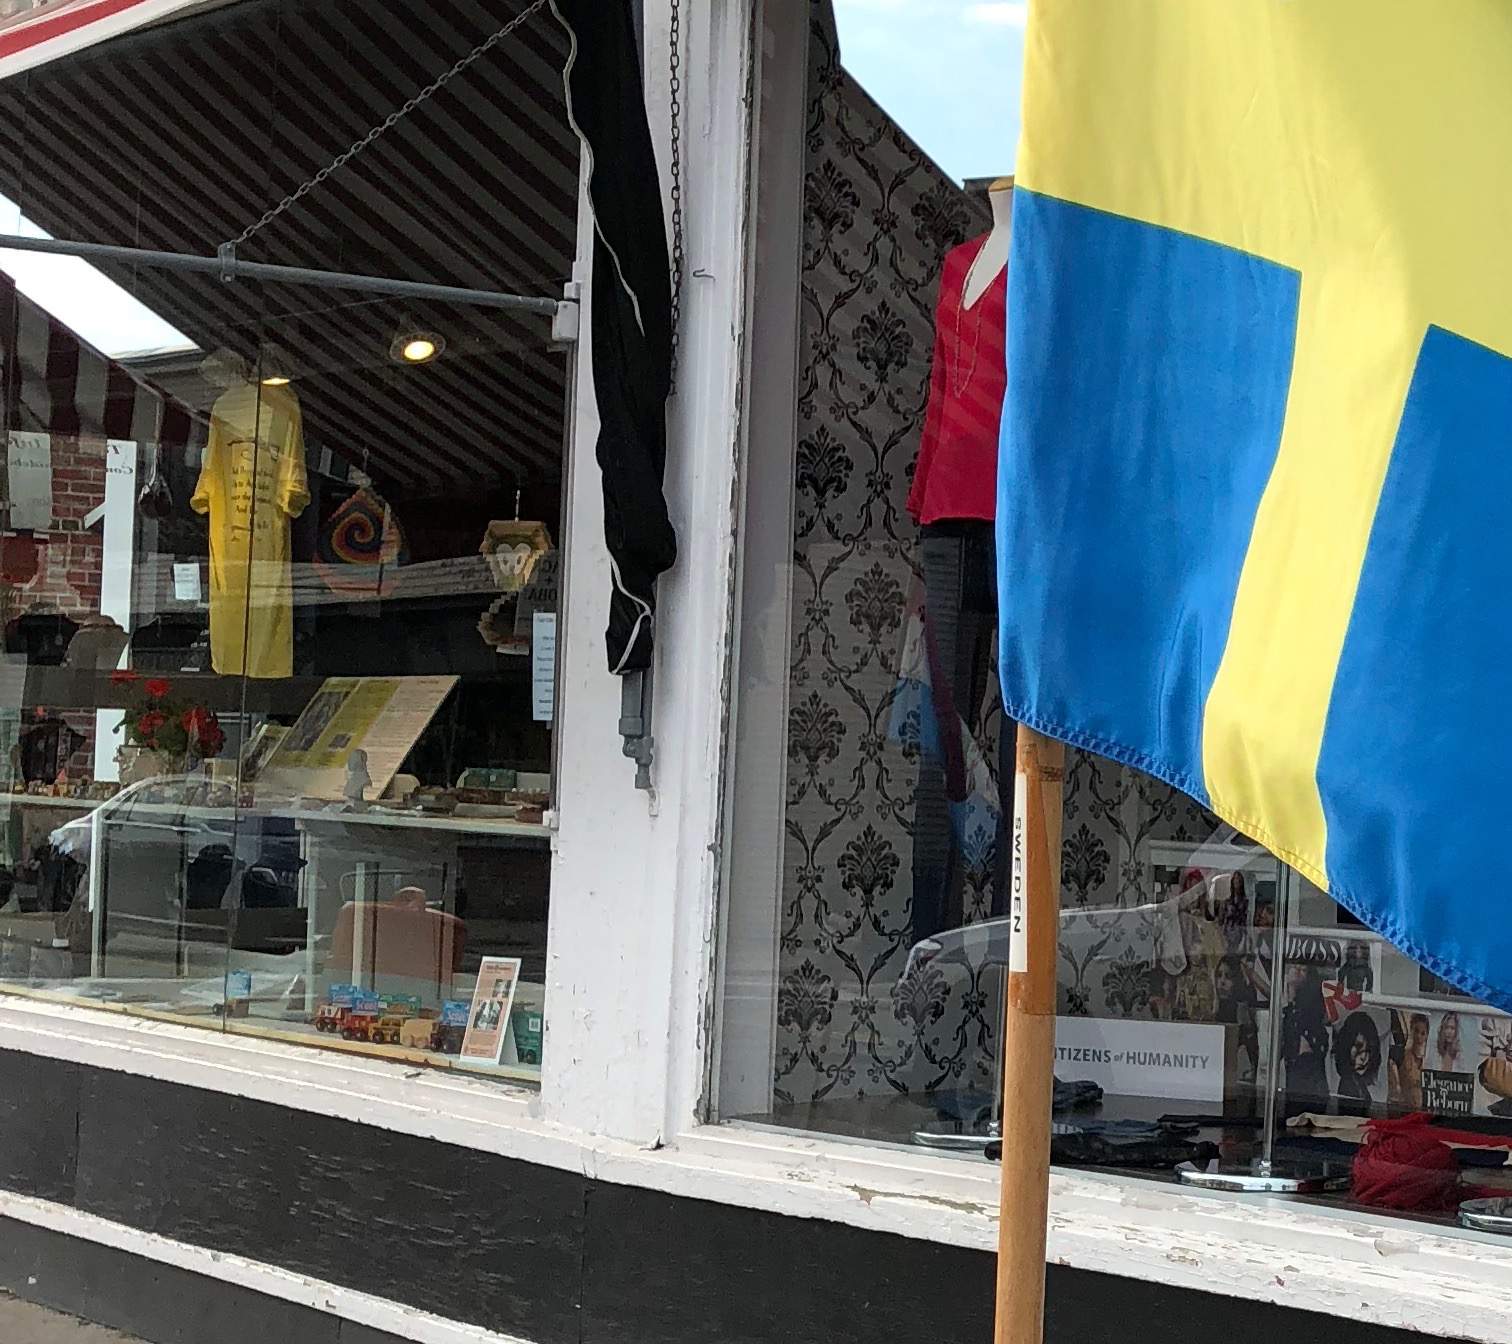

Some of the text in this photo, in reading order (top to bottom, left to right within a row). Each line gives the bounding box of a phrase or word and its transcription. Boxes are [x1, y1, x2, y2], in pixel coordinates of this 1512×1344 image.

[1012, 816, 1023, 934] SWEDEN
[1054, 1046, 1112, 1064] ITIZENS
[1125, 1051, 1211, 1069] HUMANITY
[1421, 1071, 1473, 1095] Elegance
